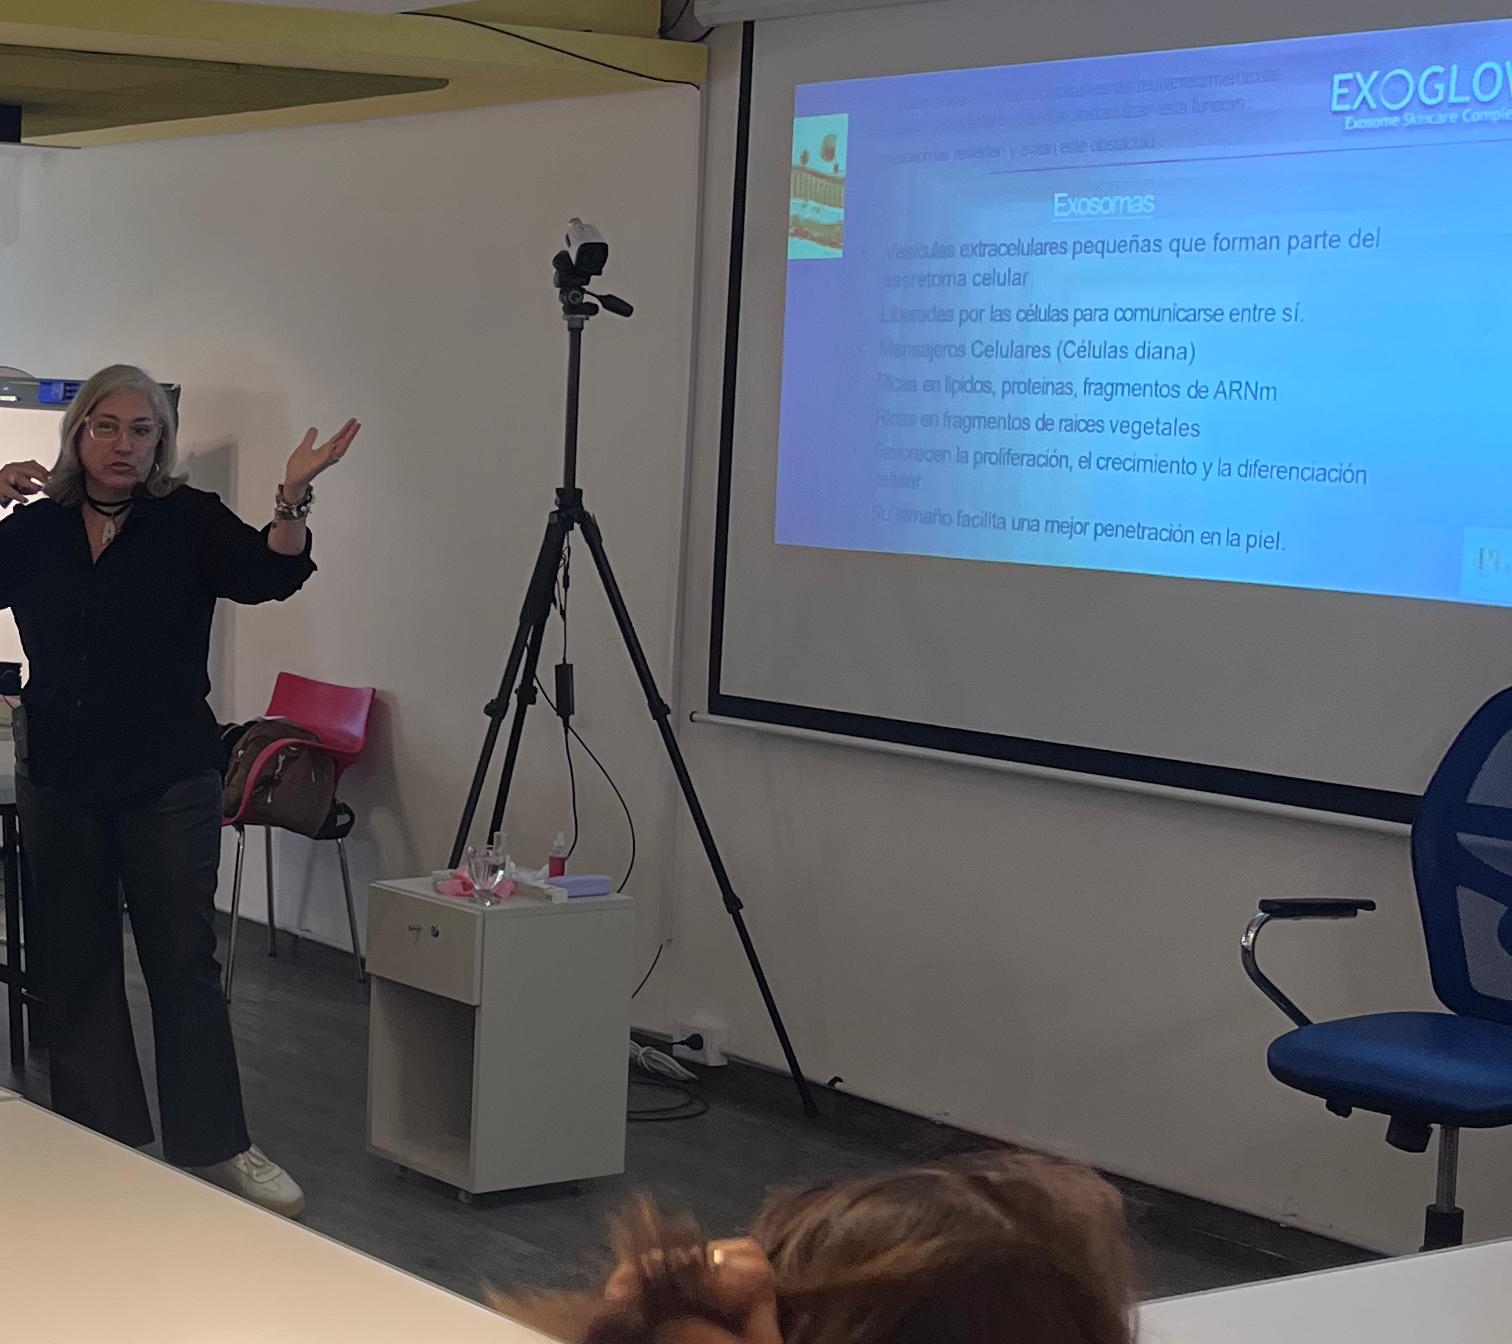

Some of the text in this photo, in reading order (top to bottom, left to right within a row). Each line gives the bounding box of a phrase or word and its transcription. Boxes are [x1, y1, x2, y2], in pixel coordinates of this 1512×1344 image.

[1344, 114, 1400, 131] Exosome
[1053, 191, 1155, 218] Exosomas
[960, 237, 1068, 258] extracelulares
[1072, 234, 1163, 260] pequeñas
[1168, 236, 1206, 258] que
[1212, 232, 1280, 252] forman
[1287, 230, 1341, 256] parte
[1348, 226, 1381, 250] del
[972, 267, 1030, 288] celular
[958, 307, 985, 328] por
[989, 303, 1012, 323] las
[1015, 303, 1069, 324] células
[1073, 306, 1109, 327] para
[1114, 302, 1225, 324] comunicarse
[1229, 303, 1276, 324] entre
[970, 339, 1051, 360] Celulares
[1056, 338, 1129, 363] (Células
[1134, 339, 1197, 366] diana)
[922, 378, 941, 394] en
[1083, 377, 1181, 402] fragmentos
[1187, 379, 1209, 400] de
[1213, 379, 1278, 402] ARNm
[920, 413, 940, 428] en
[942, 411, 1031, 434] fragmentos
[1035, 414, 1054, 432] de
[1109, 417, 1201, 440] vegetales
[956, 445, 969, 464] la
[972, 447, 1073, 473] proliferación,
[1078, 451, 1092, 470] el
[1096, 453, 1197, 476] crecimiento
[1201, 460, 1213, 481] y
[1217, 457, 1231, 478] la
[1237, 458, 1367, 485] diferenciación
[956, 508, 1007, 531] facilita
[1011, 516, 1040, 532] una
[1044, 515, 1090, 541] mejor
[1093, 522, 1194, 544] penetración
[1200, 531, 1221, 546] en
[1226, 527, 1241, 547] la
[1245, 529, 1286, 554] piel.
